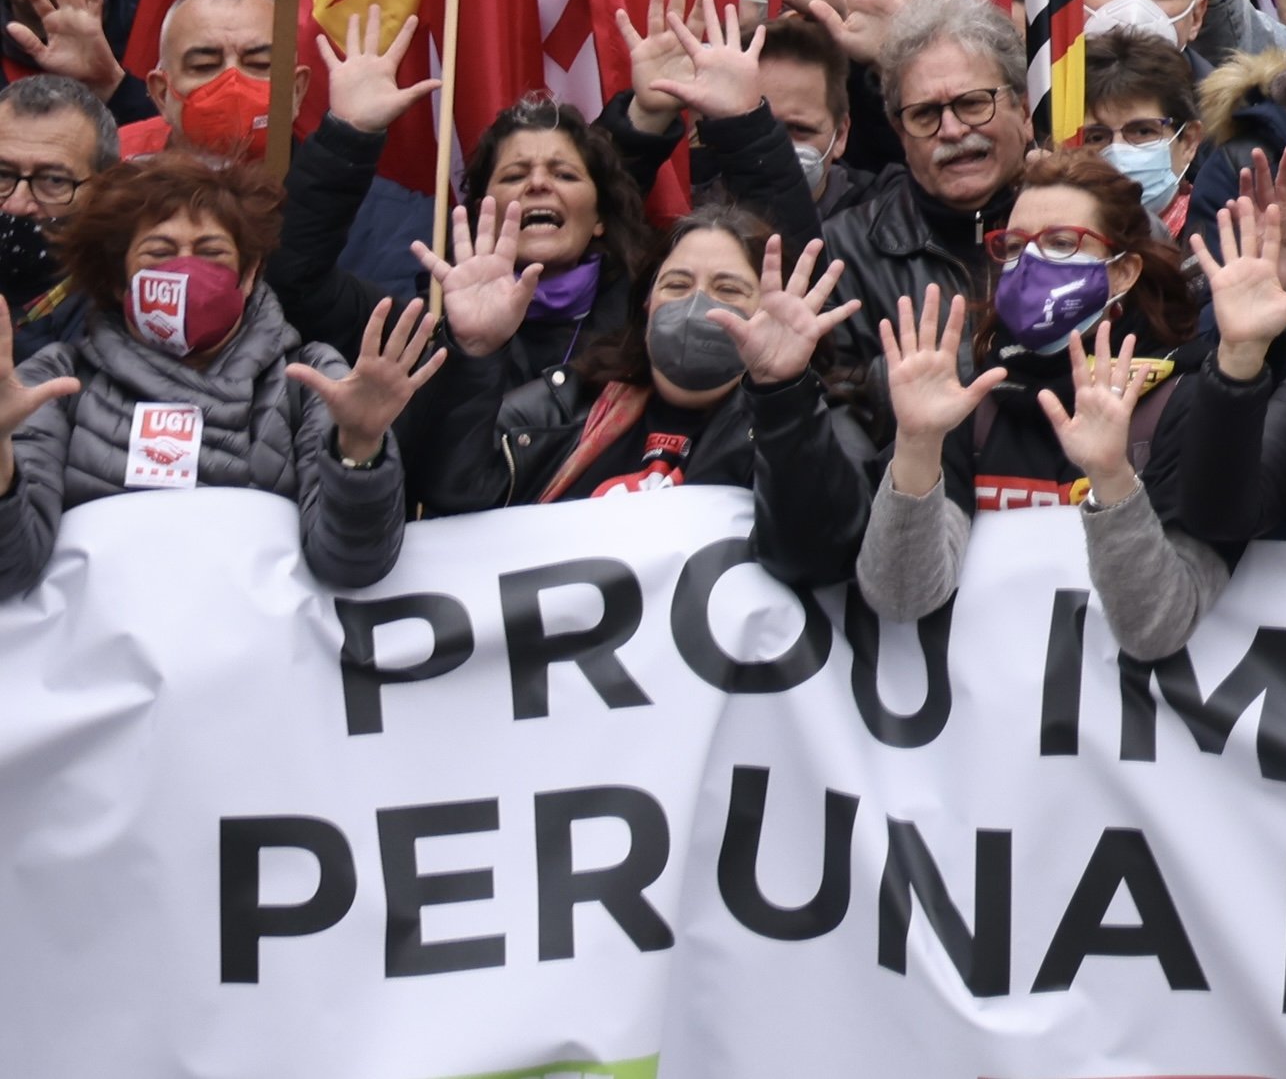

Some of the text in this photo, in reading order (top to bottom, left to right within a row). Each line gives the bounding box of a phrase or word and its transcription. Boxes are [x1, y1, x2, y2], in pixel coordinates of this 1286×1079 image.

[144, 280, 181, 306] UGT
[151, 411, 195, 433] UGT
[334, 536, 957, 749] PROU
[218, 784, 675, 985] PER
[716, 764, 1212, 998] UNA
